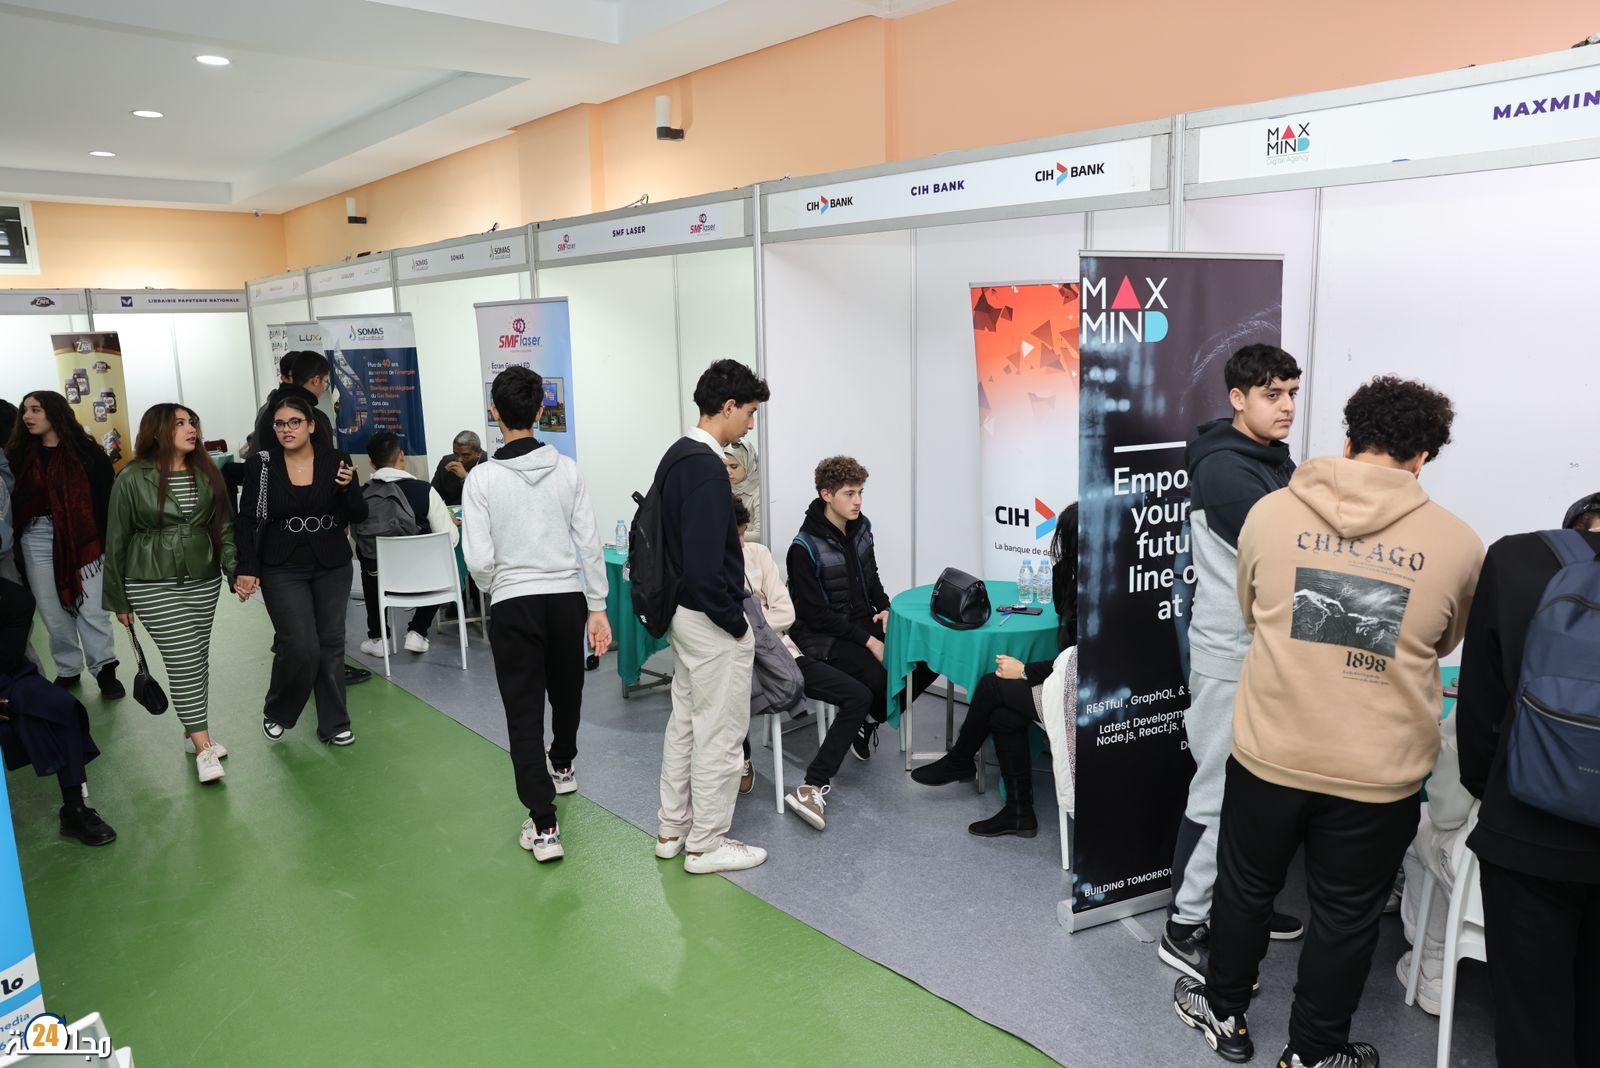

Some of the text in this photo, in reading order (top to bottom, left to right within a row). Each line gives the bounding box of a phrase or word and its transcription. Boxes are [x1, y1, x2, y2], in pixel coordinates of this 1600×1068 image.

[1267, 138, 1310, 156] MIND
[1035, 163, 1105, 182] CIH BANK
[910, 180, 965, 196] CIH BANK
[806, 196, 853, 212] CIH BANK
[612, 226, 646, 237] SMF LASER
[690, 224, 703, 234] SMF
[494, 246, 511, 254] SOMAS
[1082, 274, 1168, 309] MAX
[357, 328, 384, 336] SOMAS
[1082, 311, 1169, 344] MIND
[499, 335, 541, 348] SMF laser
[995, 506, 1029, 527] CIH
[1131, 501, 1191, 533] your
[994, 542, 1003, 550] La
[1004, 544, 1031, 555] banque
[1032, 547, 1042, 555] de
[1297, 531, 1425, 572] CHICAGO
[1129, 565, 1174, 593] line
[1158, 593, 1183, 620] at
[1346, 650, 1387, 672] 1898
[1130, 689, 1176, 706] GraphQL,
[1178, 686, 1186, 696] &
[1099, 720, 1130, 735] Latest
[1133, 710, 1184, 728] Developm
[1096, 730, 1137, 746] Node.js,
[1180, 741, 1189, 750] D
[1084, 868, 1173, 897] BUILDING TOMORRO
